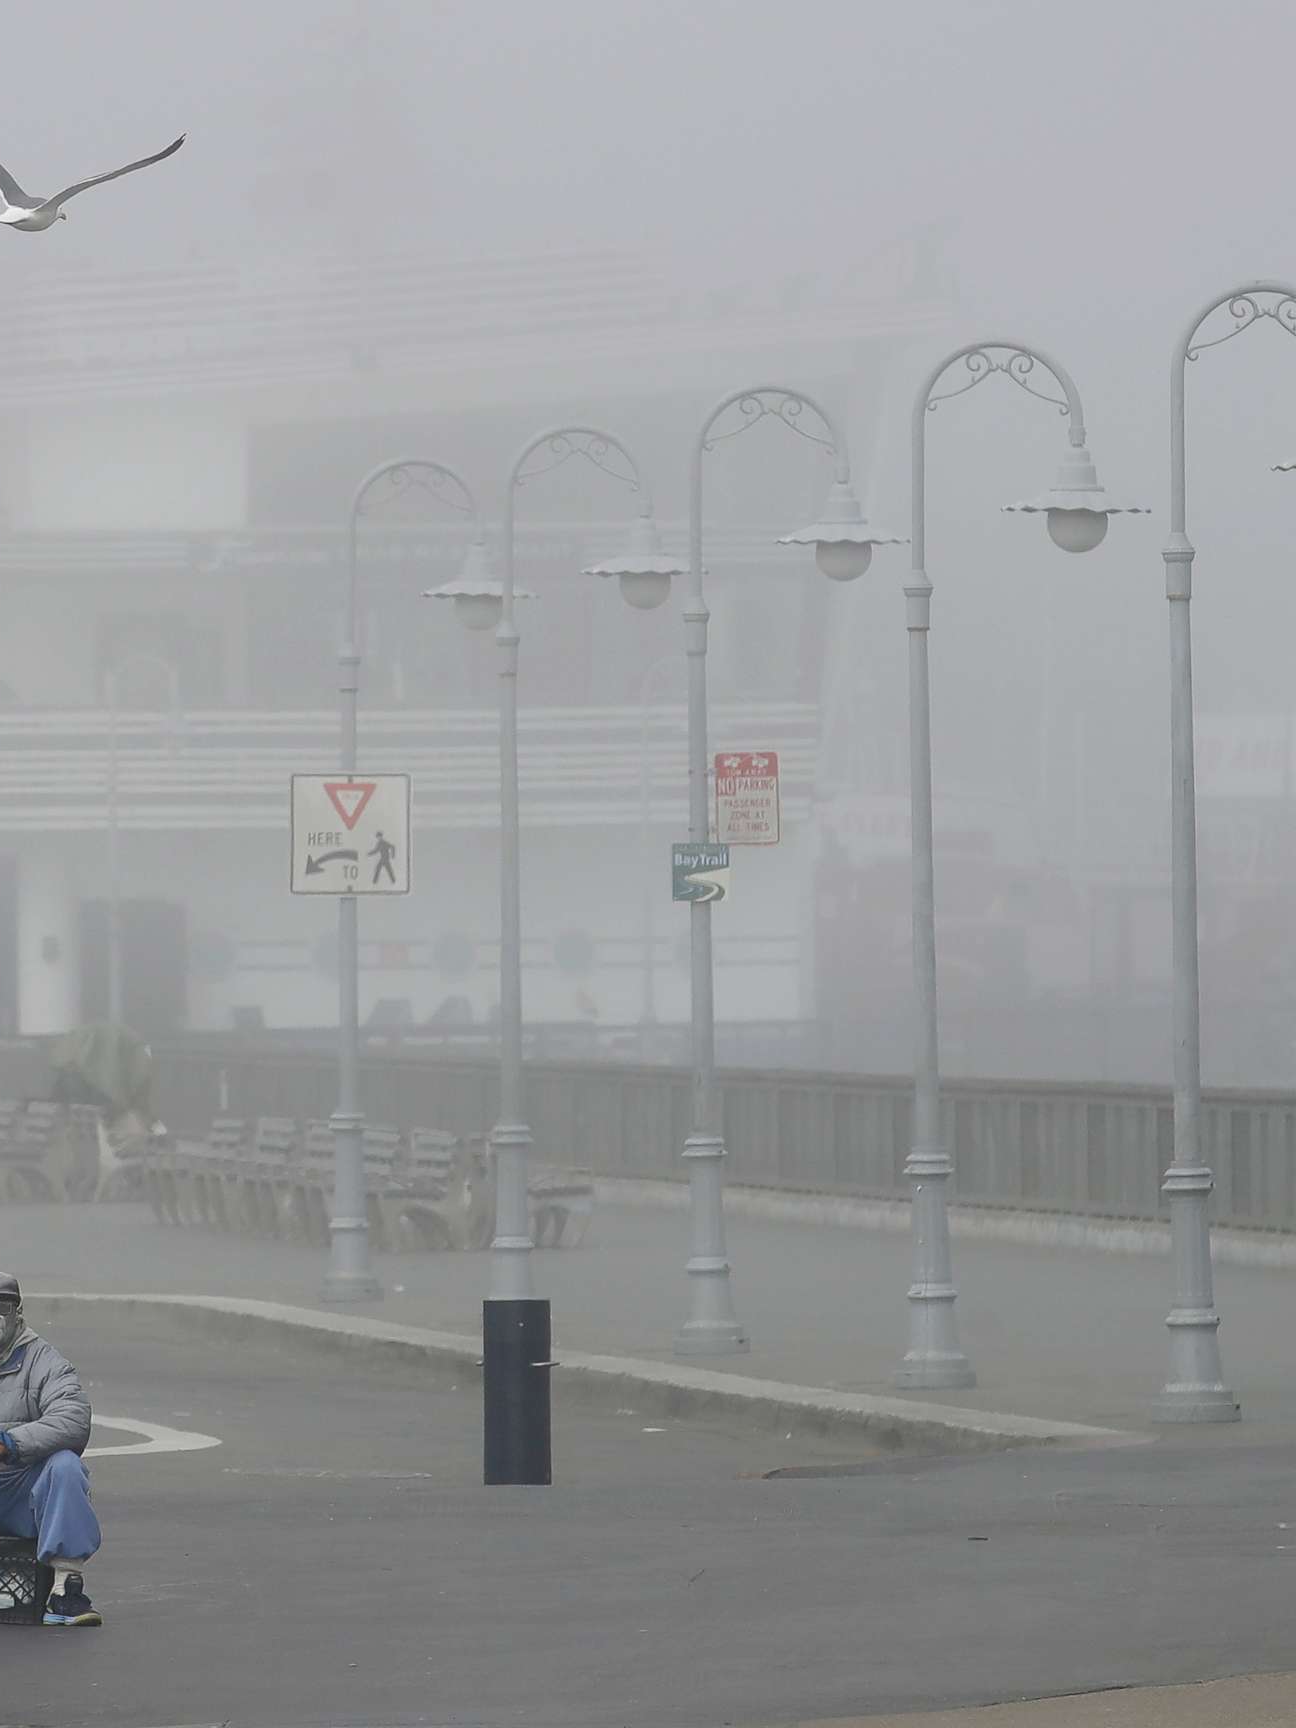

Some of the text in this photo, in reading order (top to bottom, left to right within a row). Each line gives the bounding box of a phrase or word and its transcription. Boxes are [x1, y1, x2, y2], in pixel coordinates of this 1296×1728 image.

[718, 778, 775, 794] NO PARKING
[724, 799, 771, 809] PASSENGER
[729, 812, 750, 821] ZONE
[727, 823, 769, 833] ALL TIMES
[307, 832, 343, 847] HERE
[342, 865, 359, 880] TO
